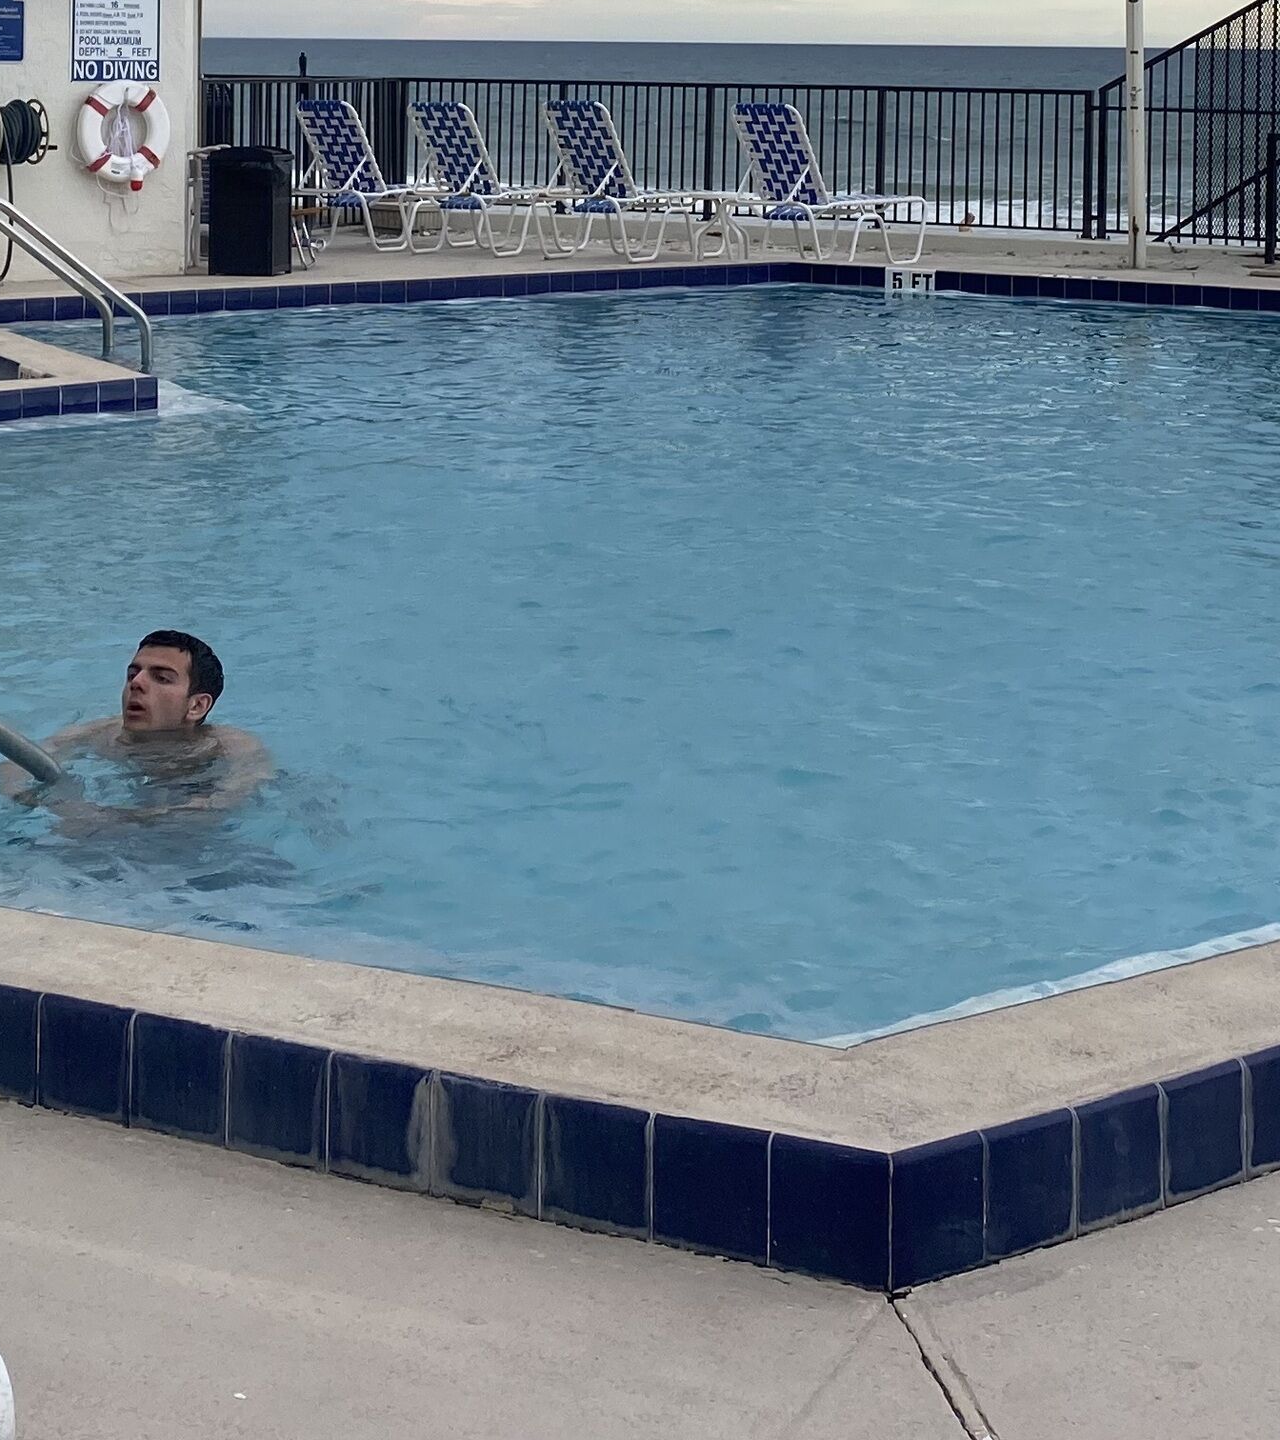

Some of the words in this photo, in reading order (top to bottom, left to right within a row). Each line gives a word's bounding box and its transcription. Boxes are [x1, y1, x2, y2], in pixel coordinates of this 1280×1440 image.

[111, 1, 119, 9] 16
[79, 36, 101, 45] POOL
[103, 36, 142, 46] MAXIMUM
[79, 47, 108, 56] DEPTH:
[117, 48, 122, 58] 5
[132, 48, 152, 57] FEET
[74, 61, 98, 79] NO
[103, 61, 158, 80] DIVING
[892, 272, 903, 289] 5
[912, 273, 933, 291] FT
